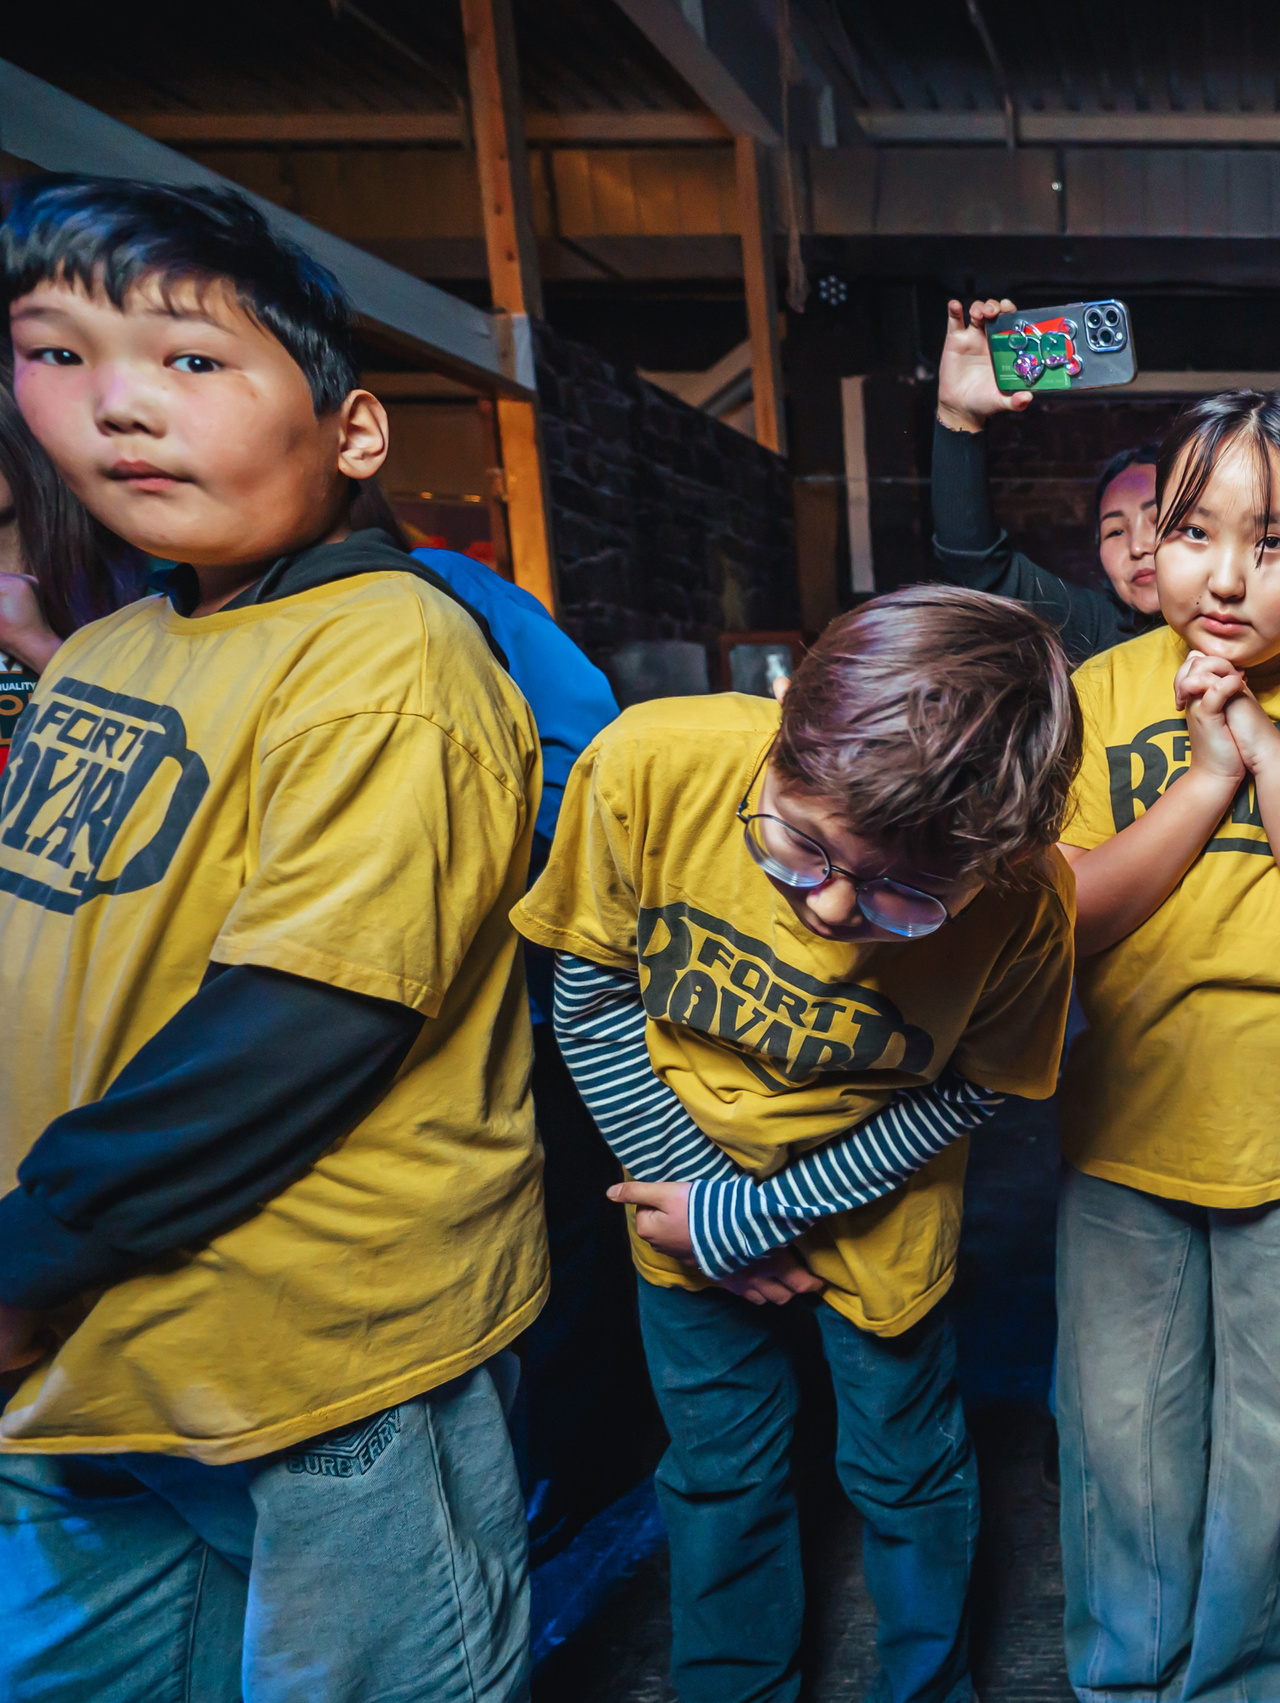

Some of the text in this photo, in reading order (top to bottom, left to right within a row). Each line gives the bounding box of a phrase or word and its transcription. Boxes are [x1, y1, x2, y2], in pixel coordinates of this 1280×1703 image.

[0, 682, 37, 692] UALITY
[33, 700, 146, 763] FORT
[698, 937, 847, 1033] FORT
